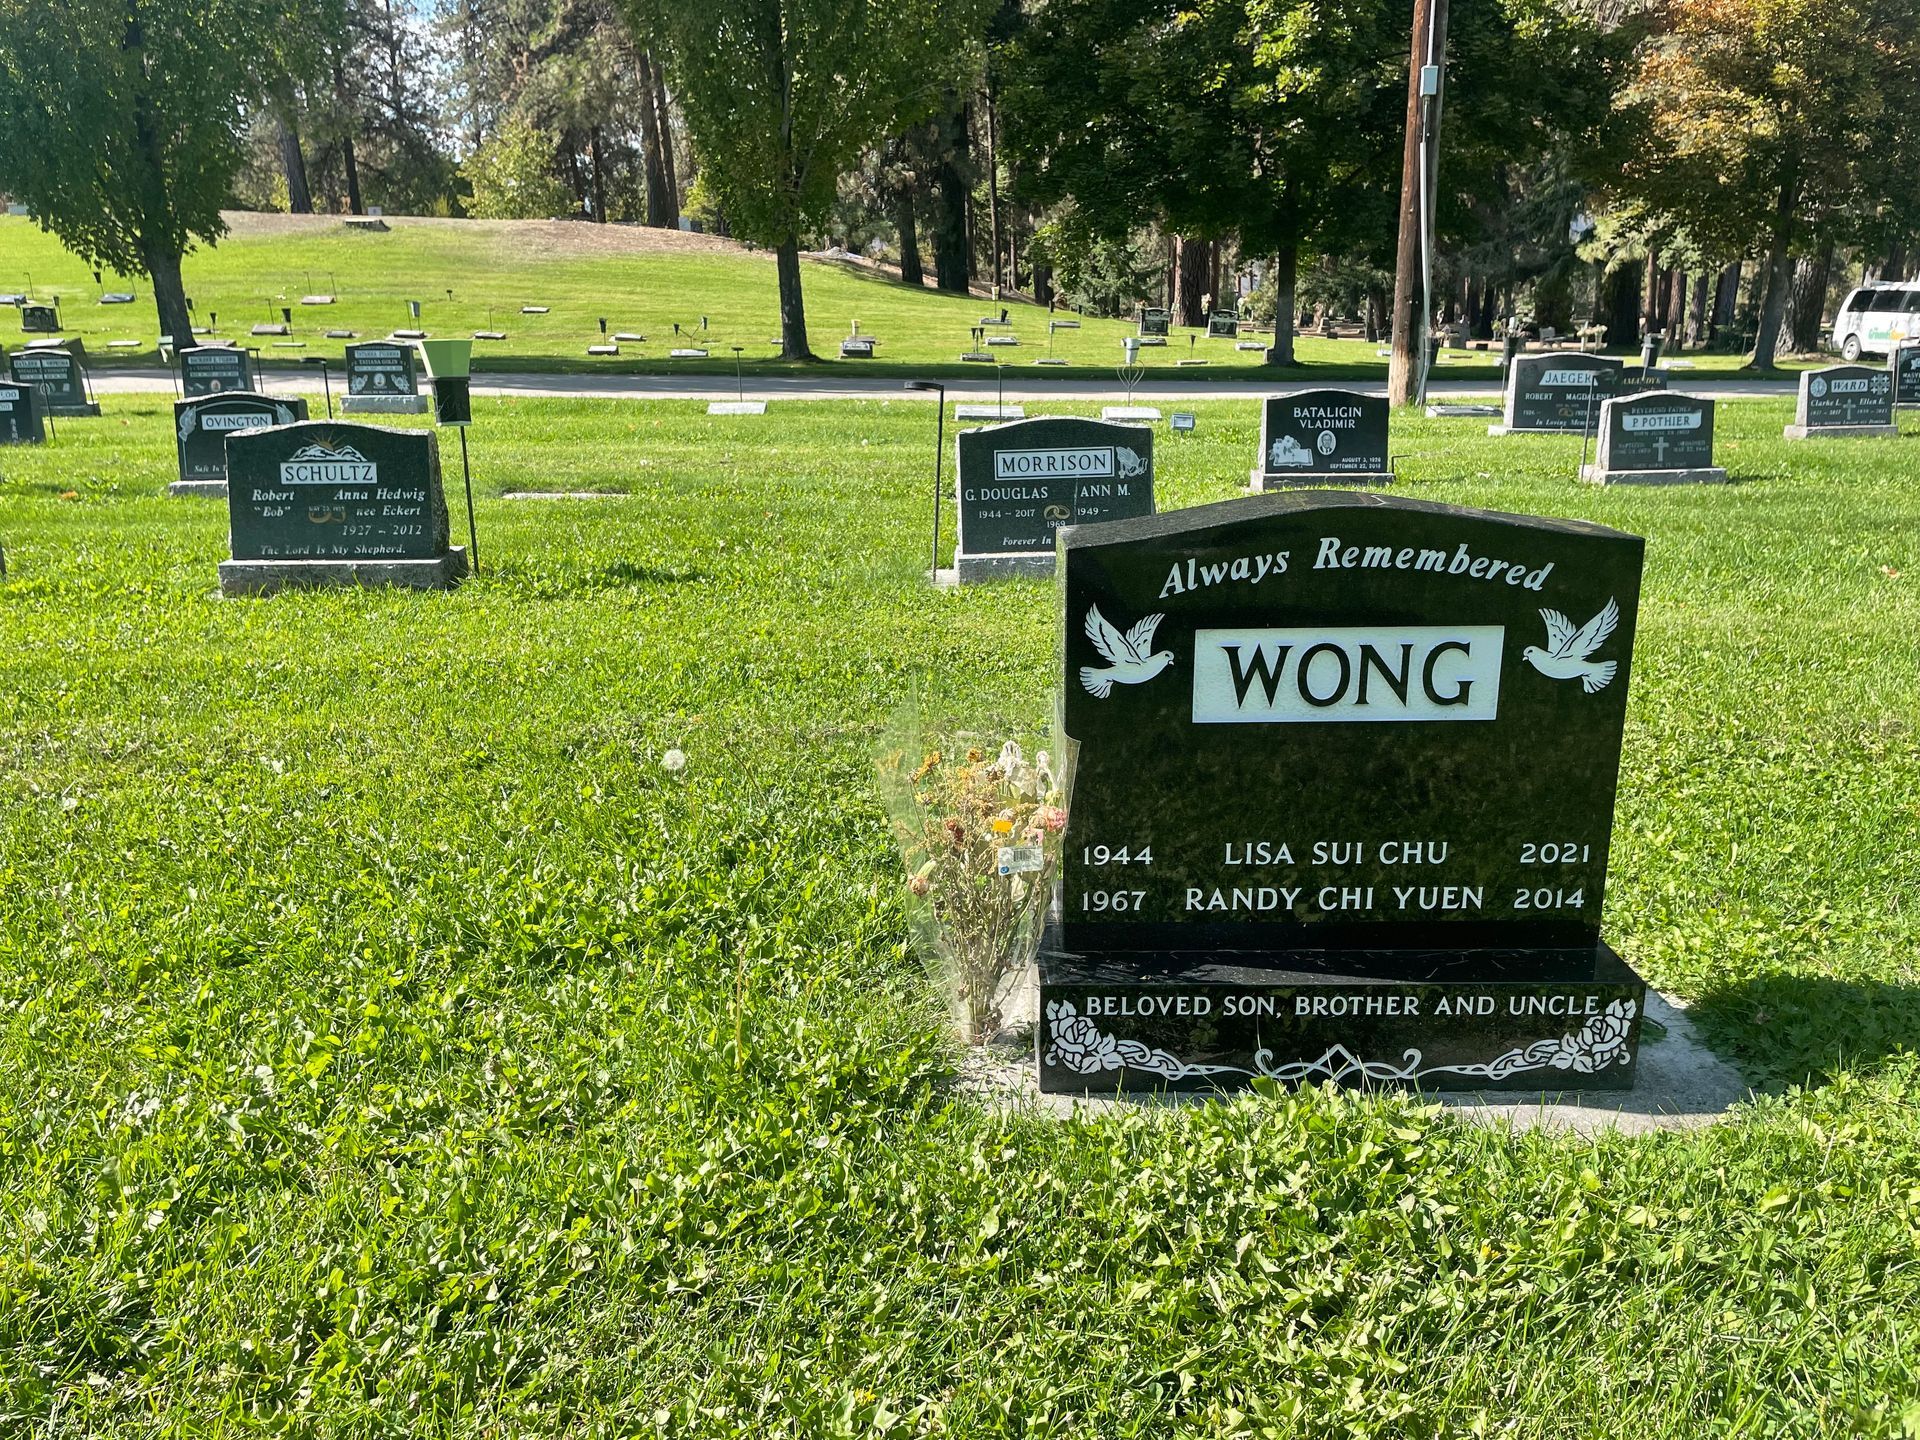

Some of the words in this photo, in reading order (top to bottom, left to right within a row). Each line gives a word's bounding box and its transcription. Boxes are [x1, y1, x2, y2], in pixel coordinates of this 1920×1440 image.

[1545, 373, 1591, 384] JAEGER
[1833, 382, 1866, 390] WARD
[1293, 407, 1362, 418] BATALIGIN
[206, 416, 268, 427] OVINGTON
[1300, 420, 1356, 429] VLADIMIR
[1642, 416, 1690, 427] POTHIER
[1002, 453, 1107, 473] MORRISON
[284, 465, 374, 482] SCHULTZ
[252, 489, 295, 501] Robert
[333, 488, 368, 500] Anna
[376, 488, 425, 502] Hedwig
[964, 489, 977, 501] G.
[981, 486, 1048, 500] DOUGLAS
[1080, 484, 1111, 497] ANN
[1117, 484, 1131, 496] M.
[383, 505, 421, 516] Eckert
[979, 510, 1002, 519] 1944
[1015, 509, 1036, 518] 2017
[1077, 507, 1099, 516] 1949
[342, 525, 371, 536] 1927
[393, 525, 422, 535] 2012
[1046, 520, 1066, 529] 1969
[1002, 537, 1036, 546] Forever
[1041, 536, 1052, 545] In
[260, 545, 280, 555] The
[286, 545, 310, 555] Lord
[331, 545, 349, 556] My
[354, 544, 406, 556] Shepherd.
[1158, 550, 1290, 599] Always
[1313, 537, 1555, 593] Remembered
[1220, 641, 1476, 710] WONG
[1082, 845, 1154, 867] 1944
[1223, 842, 1295, 866] LISA
[1311, 842, 1363, 866] SUI
[1379, 841, 1449, 865] CHU
[1519, 842, 1591, 865] 2021
[1081, 891, 1147, 913] 1967
[1185, 887, 1302, 911] RANDY
[1318, 886, 1374, 911] CHI
[1392, 886, 1484, 910] YUEN
[1513, 887, 1585, 910] 2014
[1086, 996, 1211, 1016] BELOVED
[1222, 996, 1282, 1019] SON,
[1295, 996, 1421, 1016] BROTHER
[1435, 996, 1496, 1016] AND
[1509, 995, 1600, 1016] UNCLE
